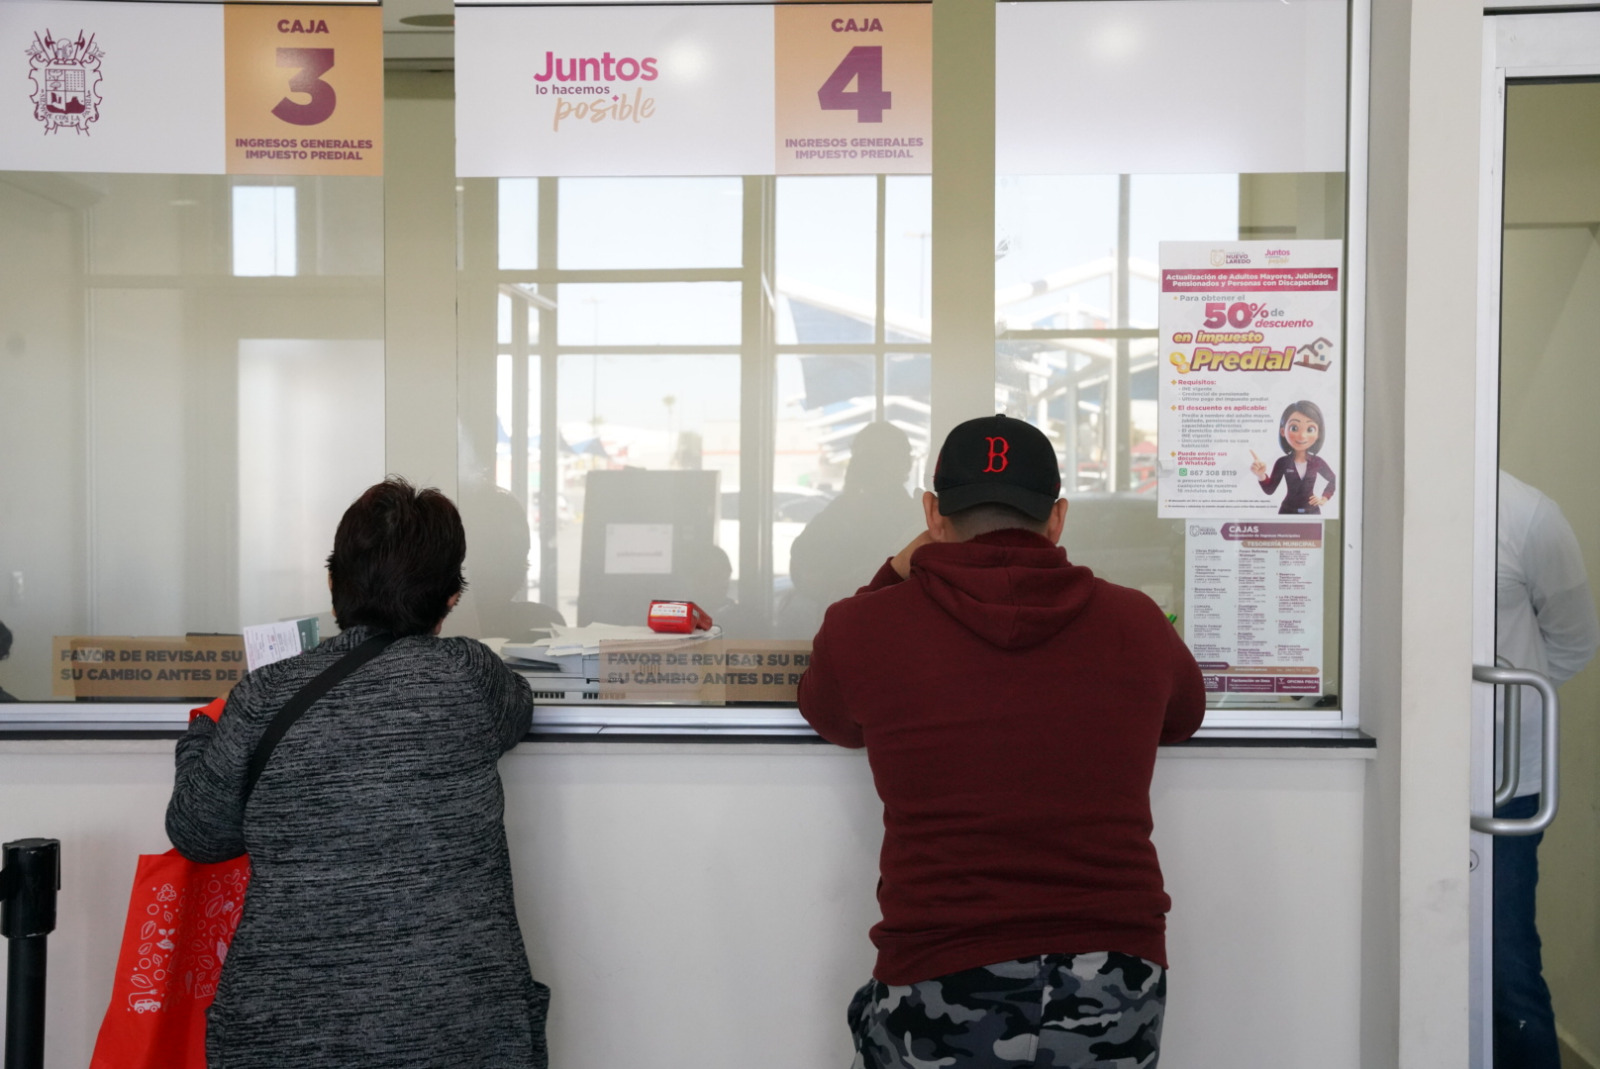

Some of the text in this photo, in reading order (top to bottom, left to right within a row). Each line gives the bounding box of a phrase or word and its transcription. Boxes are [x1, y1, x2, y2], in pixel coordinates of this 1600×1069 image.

[277, 19, 329, 34] CAJA
[831, 18, 883, 32] CAJA
[533, 51, 658, 82] Juntos
[271, 48, 336, 126] 3
[536, 84, 610, 94] lo hacemos
[818, 46, 891, 123] 4
[553, 87, 656, 132] posible
[236, 139, 372, 148] INGRESOS GENERALES
[785, 138, 923, 147] INGRESOS GENERALES
[246, 151, 363, 160] IMPUESTO PREDIAL
[796, 149, 913, 159] IMPUESTO PREDIAL
[1203, 302, 1284, 329] 50% de
[1255, 319, 1313, 328] descuento
[1173, 330, 1263, 345] en impuesto
[1190, 346, 1296, 371] Predial
[982, 436, 1010, 473] B
[61, 650, 242, 662] FAVOR DE REVISAR SU
[608, 654, 662, 666] FAVOR
[666, 654, 687, 666] DE
[692, 654, 763, 666] REVISAR
[767, 654, 790, 666] SU
[61, 669, 83, 681] SU
[87, 669, 152, 681] CAMBIO
[156, 669, 211, 681] ANTES
[216, 669, 238, 681] DE
[608, 673, 629, 685] SU
[633, 673, 698, 685] CAMBIO
[703, 673, 757, 685] ANTES
[762, 673, 784, 685] DE
